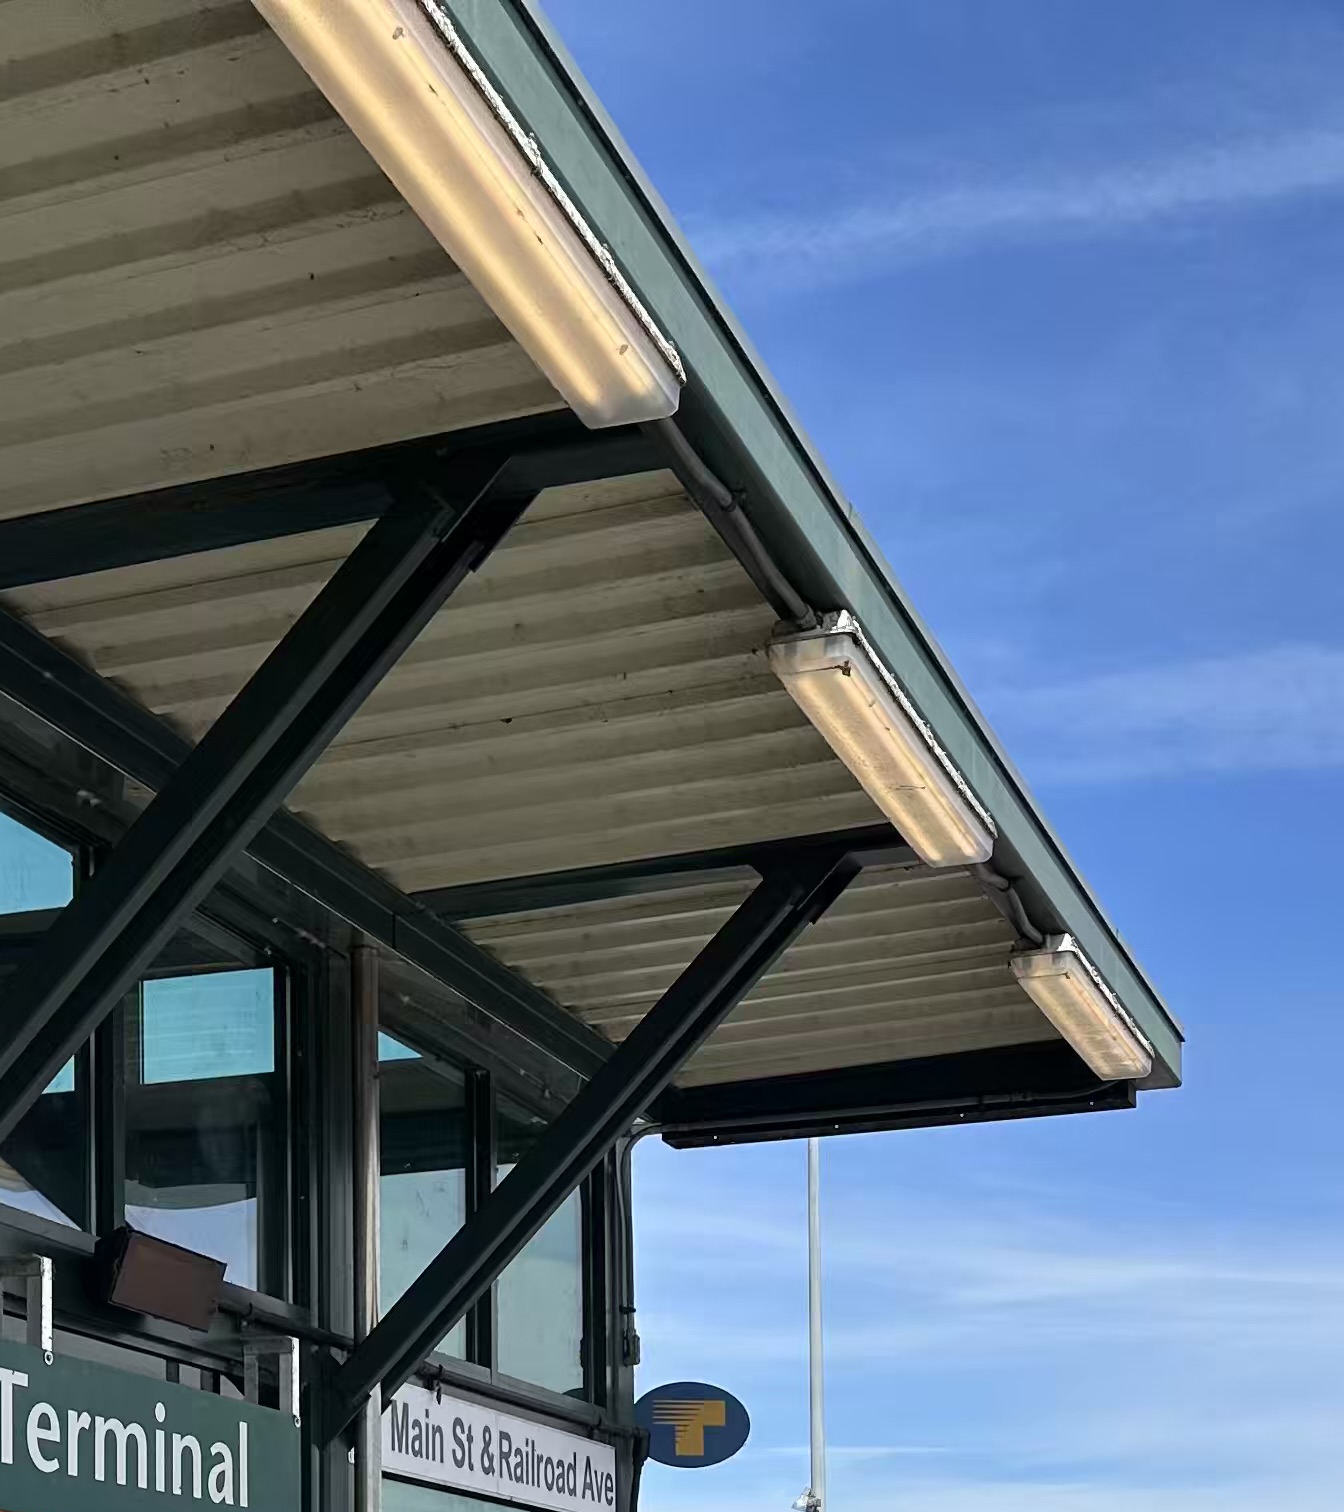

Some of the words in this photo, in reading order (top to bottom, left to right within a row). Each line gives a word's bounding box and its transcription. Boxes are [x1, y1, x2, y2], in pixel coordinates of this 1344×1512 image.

[390, 1400, 444, 1464] Main
[452, 1416, 474, 1472] St
[498, 1430, 576, 1498] Railroad
[582, 1456, 614, 1506] Ave
